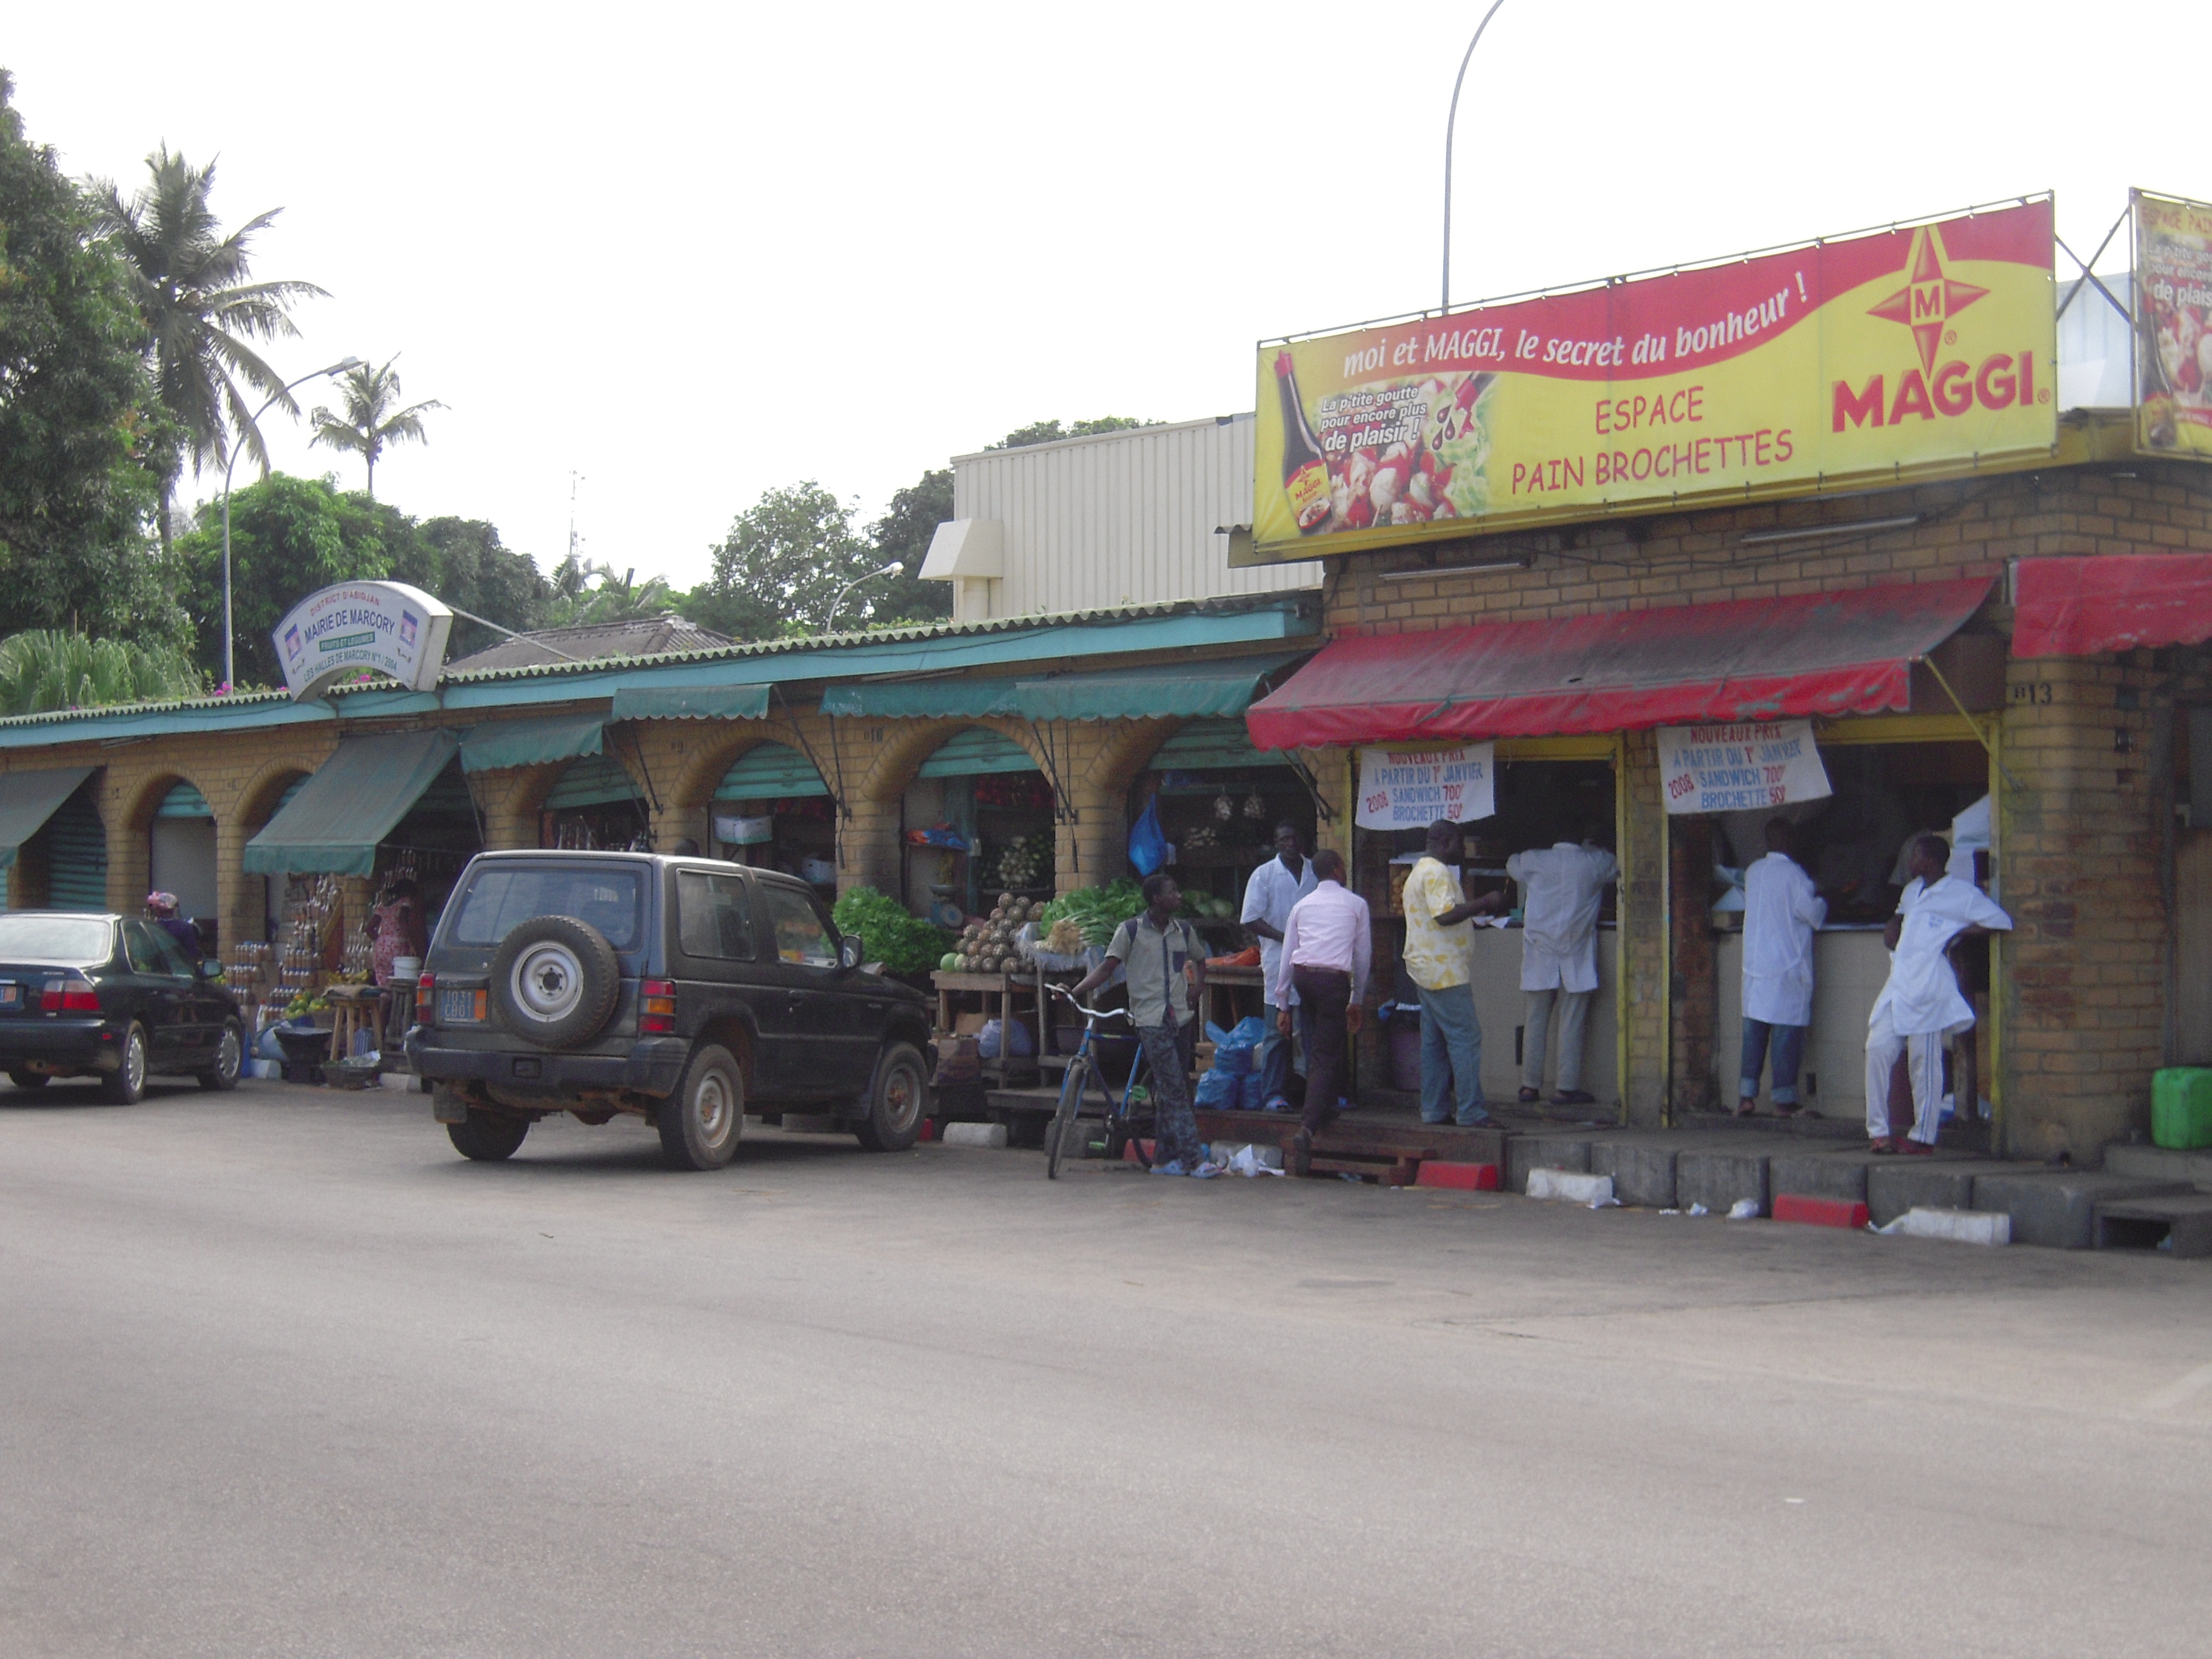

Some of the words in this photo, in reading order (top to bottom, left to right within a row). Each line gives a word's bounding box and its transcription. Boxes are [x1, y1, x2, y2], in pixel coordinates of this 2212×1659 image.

[2153, 278, 2173, 301] de
[1914, 286, 1940, 318] M
[1343, 338, 1386, 378] moi
[1393, 337, 1418, 366] et
[1424, 328, 1506, 363] MAGGI,
[1515, 329, 1539, 359] le
[1543, 336, 1624, 366] secret
[1632, 333, 1666, 365] du
[1675, 287, 1789, 358] bonheur
[1322, 398, 1336, 412] La
[1339, 394, 1373, 413] p'tite
[1375, 386, 1419, 407] goutte
[1831, 350, 2034, 434] MAGGI
[1321, 415, 1350, 432] pour
[1353, 408, 1396, 424] encore
[1399, 403, 1427, 420] plus
[1595, 386, 1703, 435] ESPACE
[1324, 429, 1347, 452] de
[1349, 421, 1408, 453] plaisir
[1512, 457, 1584, 495] PAIN
[1595, 429, 1794, 486] BROCHETTES
[310, 593, 340, 616] DISTRICT
[304, 614, 333, 644] MAIRIE
[336, 610, 347, 628] DE
[350, 609, 395, 635] MARCORY
[304, 667, 314, 682] LES
[1691, 725, 1751, 745] NOUVEAUX
[1755, 723, 1782, 740] PRIX
[1441, 748, 1465, 763] PRIX
[1683, 747, 1723, 768] PARTIR
[1728, 746, 1743, 766] DU
[1381, 766, 1415, 785] PARTIR
[1416, 766, 1430, 785] DU
[1443, 762, 1484, 782] JANVIER
[1699, 768, 1761, 788] SANDWICH
[1392, 786, 1440, 803] SANDWICH
[1669, 773, 1694, 799] 2008
[1701, 788, 1768, 809] BROCHETTE
[1392, 804, 1444, 822] BROCHETTE
